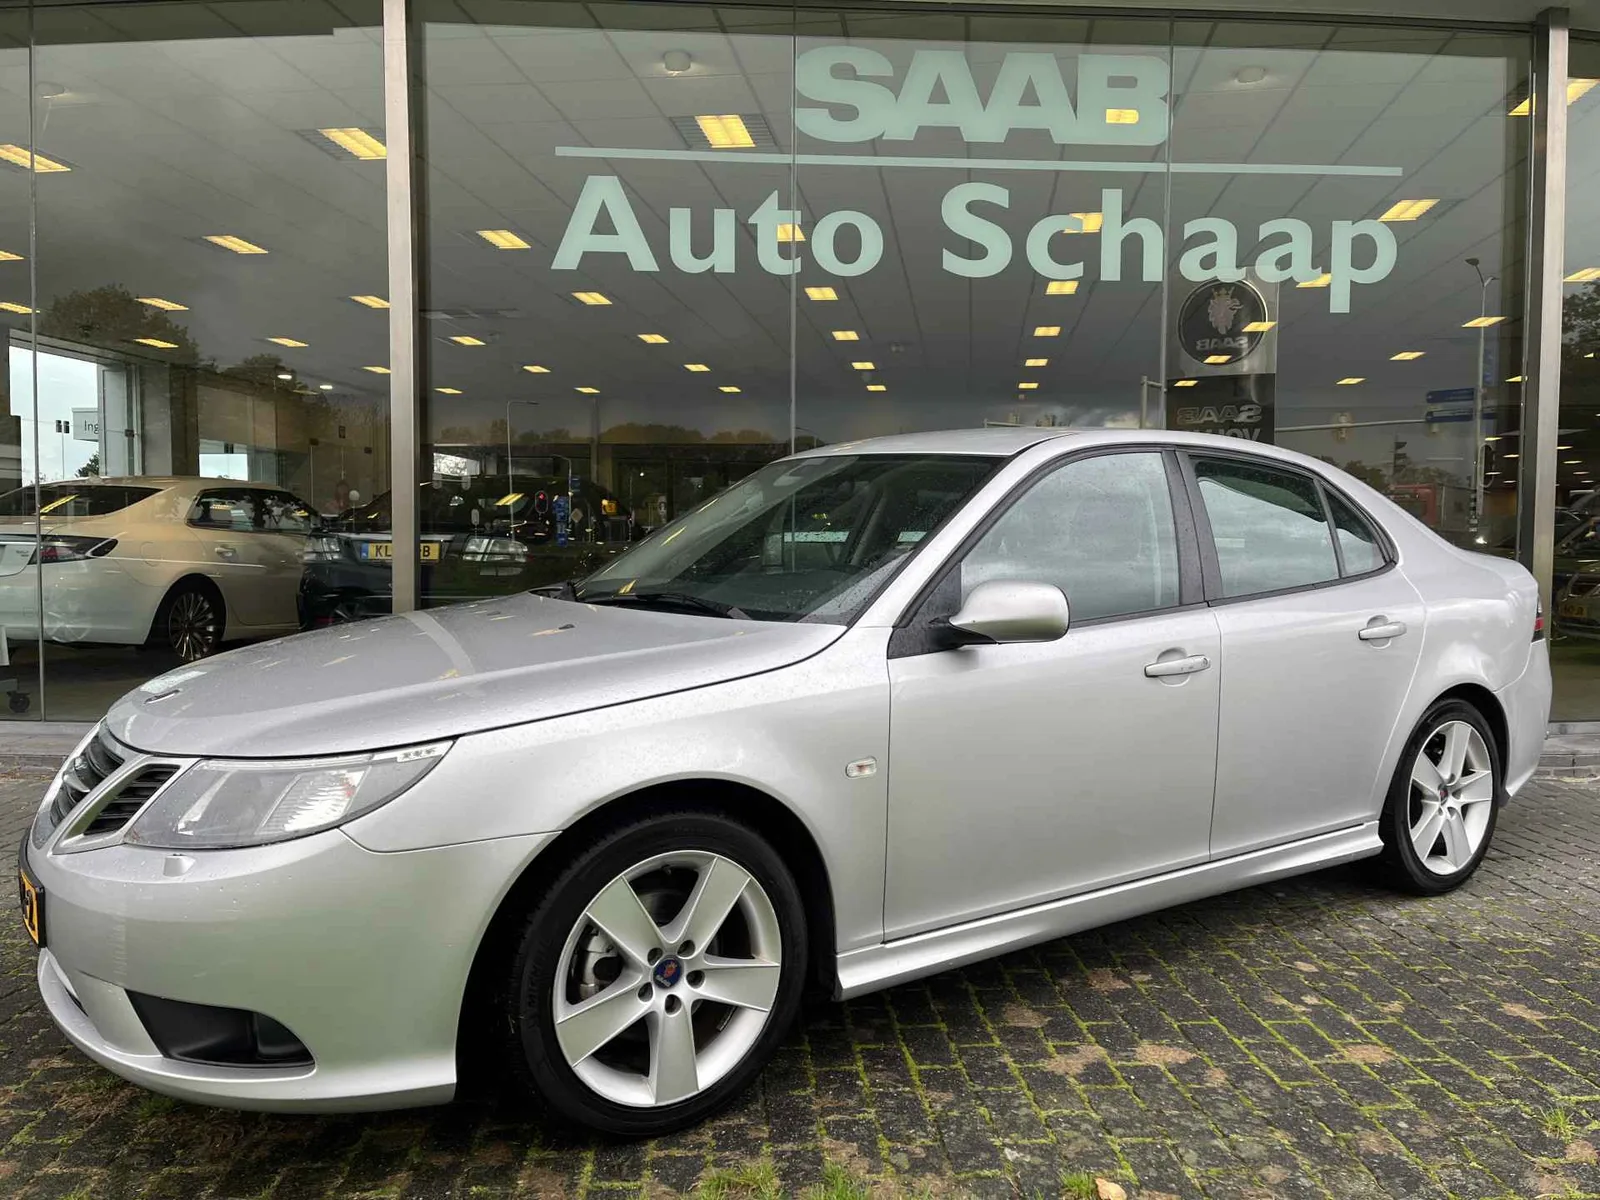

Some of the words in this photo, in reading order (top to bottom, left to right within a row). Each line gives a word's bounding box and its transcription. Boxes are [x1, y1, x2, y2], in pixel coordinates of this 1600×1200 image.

[795, 45, 1171, 146] SAAB
[550, 175, 884, 277] Auto
[941, 181, 1397, 314] Schaap
